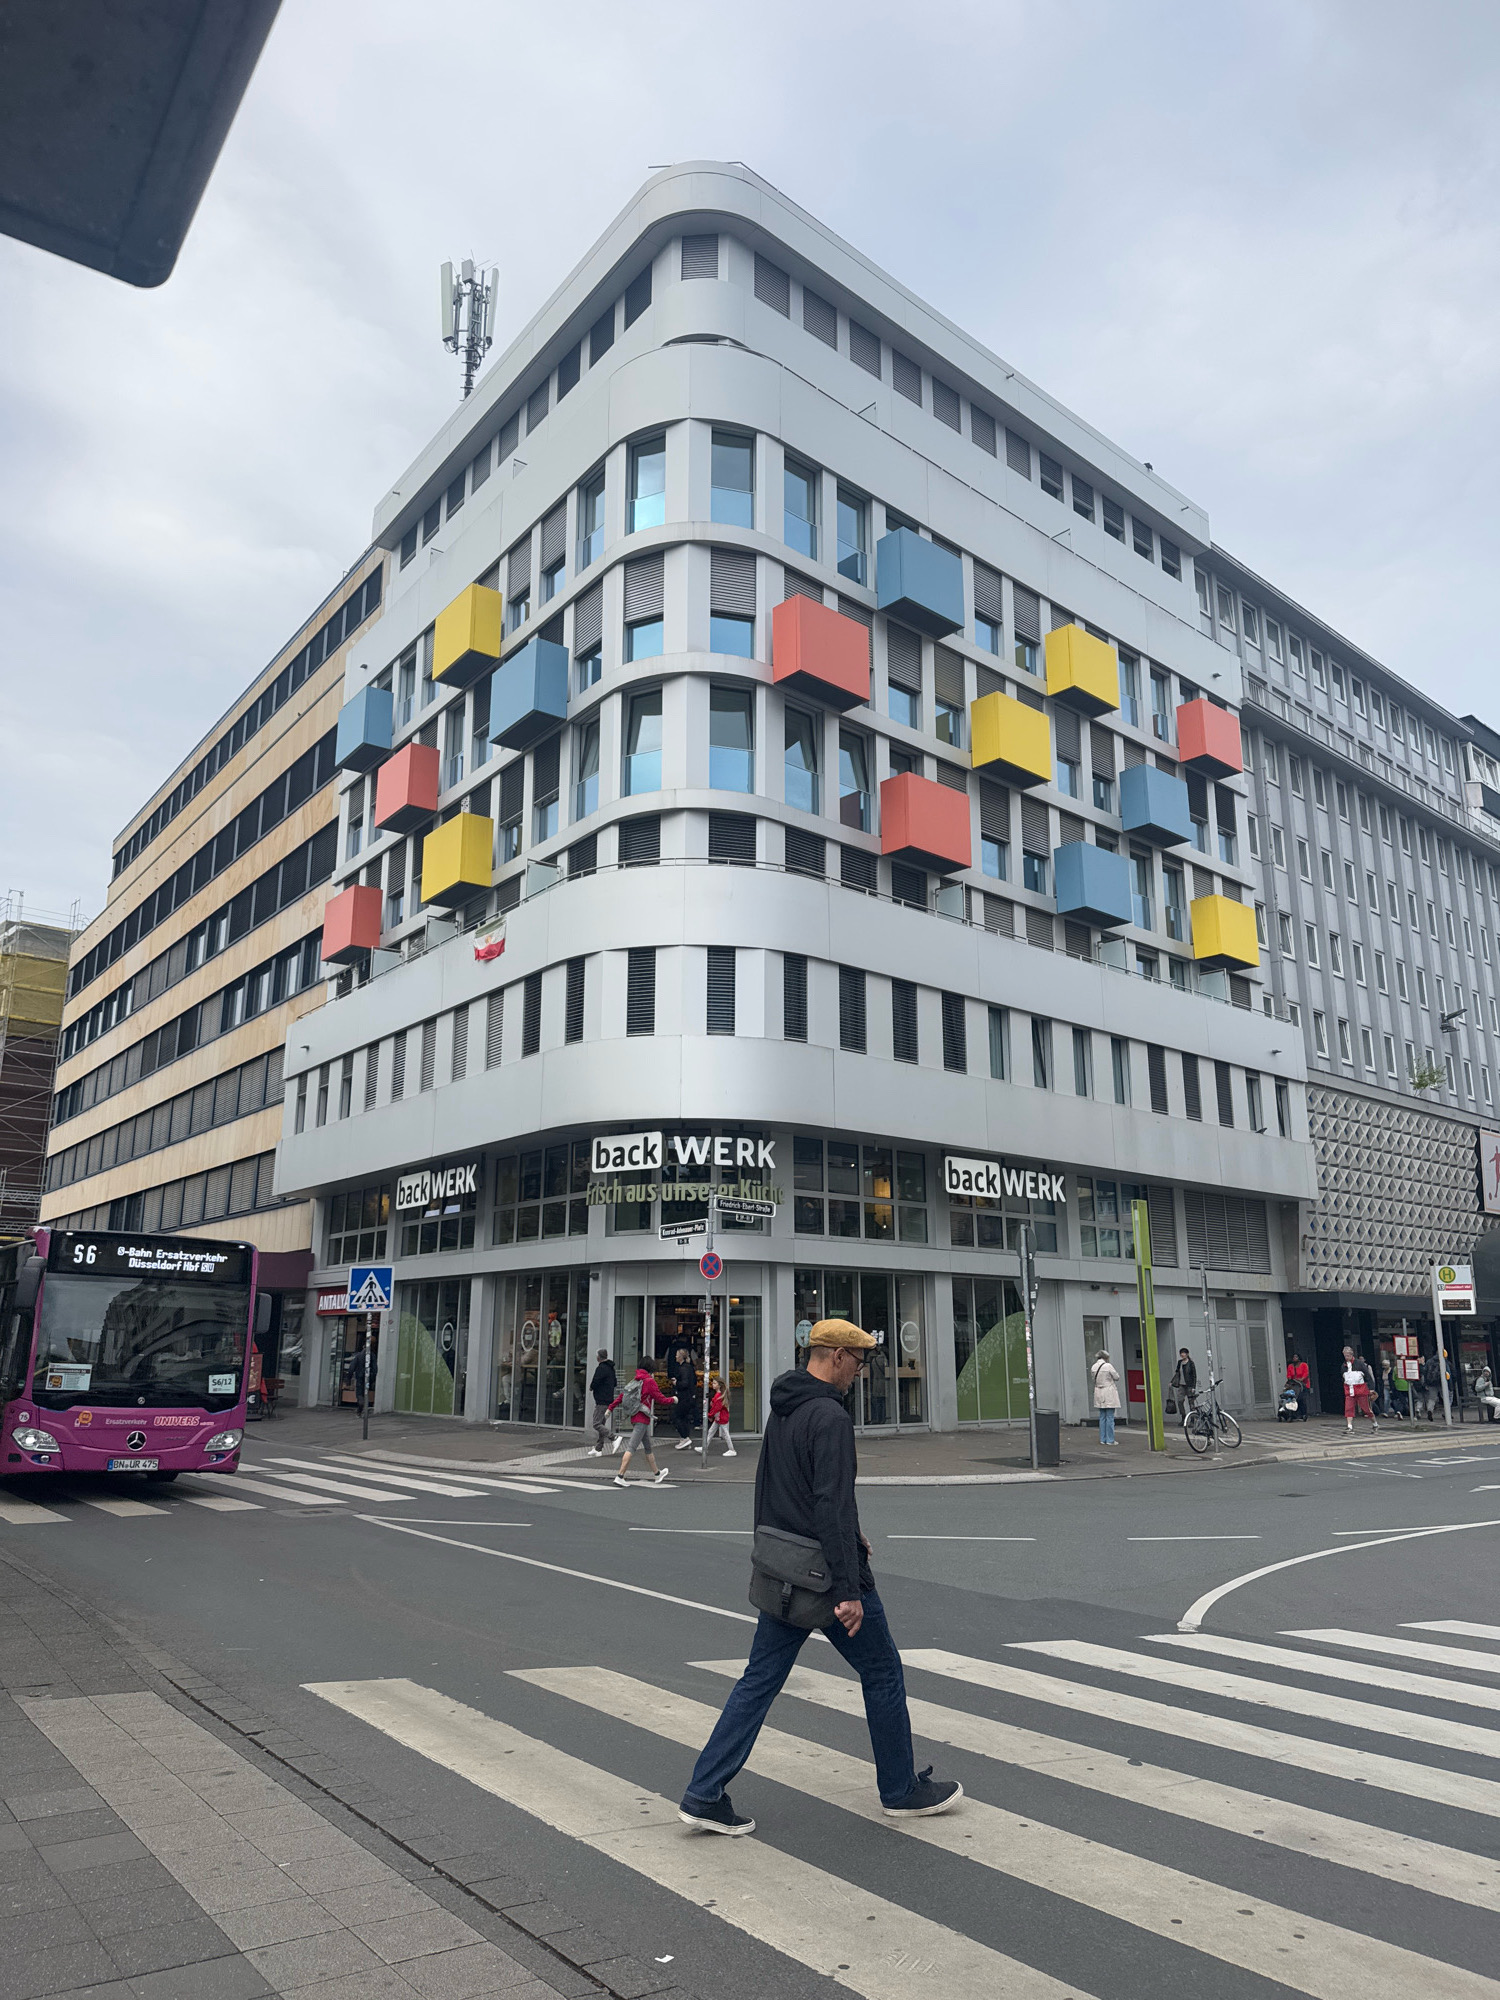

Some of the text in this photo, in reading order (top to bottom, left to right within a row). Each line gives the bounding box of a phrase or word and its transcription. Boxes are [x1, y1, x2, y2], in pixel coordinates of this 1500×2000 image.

[595, 1136, 776, 1169] back WERK
[398, 1163, 477, 1207] back WERK
[947, 1160, 1067, 1203] back WERK
[586, 1178, 622, 1206] Frisch
[625, 1182, 659, 1202] aus
[73, 1243, 228, 1264] S6 S-Bahn Ersatzverkehr
[128, 1257, 182, 1271] Düsseldorf
[183, 1261, 200, 1272] Hbf
[318, 1293, 349, 1311] ANTALYA
[211, 1378, 232, 1387] S6/12
[105, 1418, 148, 1426] Ersatzverkehr
[153, 1416, 200, 1427] UNIVERS
[113, 1459, 158, 1469] BN UR 475
